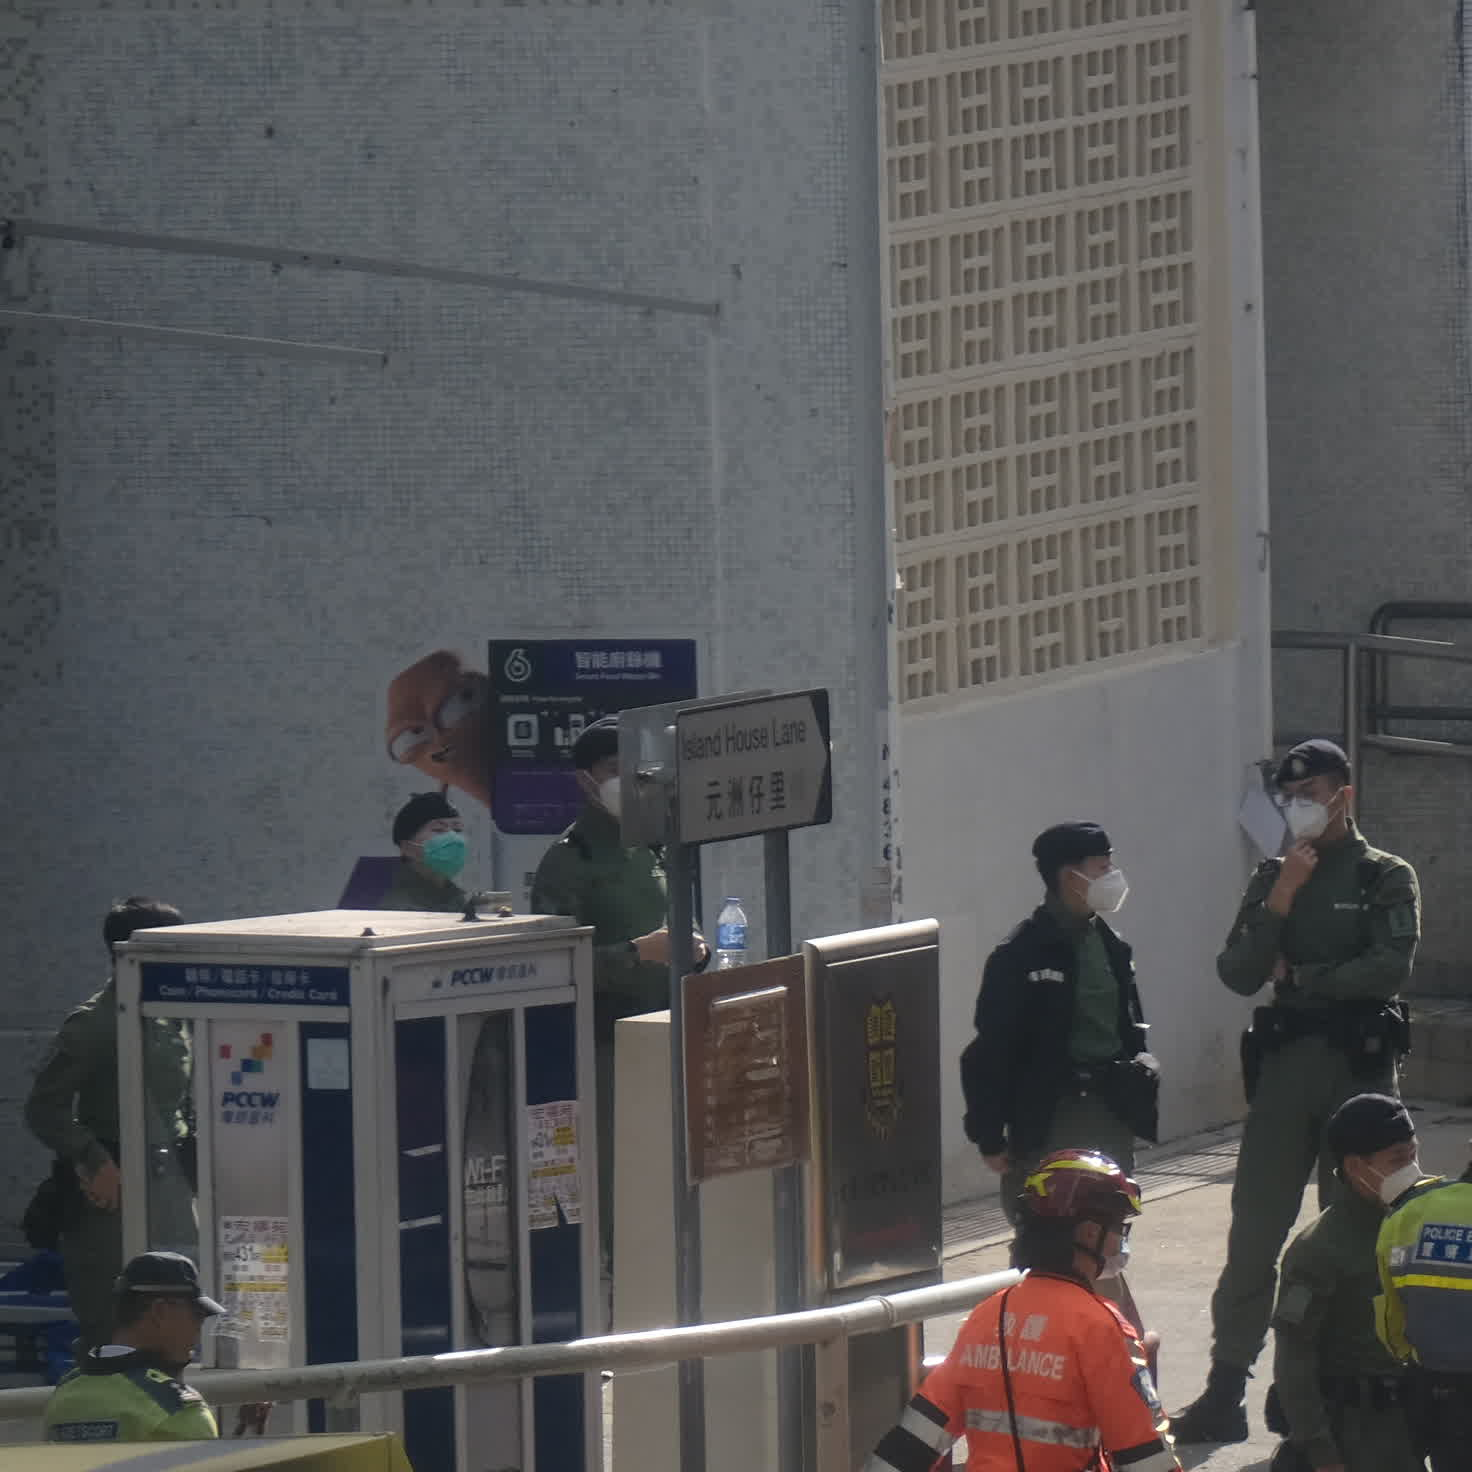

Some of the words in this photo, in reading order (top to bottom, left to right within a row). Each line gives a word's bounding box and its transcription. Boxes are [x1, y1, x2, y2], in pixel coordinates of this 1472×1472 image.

[682, 729, 722, 761] Island
[723, 722, 768, 755] House
[772, 716, 806, 747] Lane
[705, 770, 786, 822] 元洲仔里
[451, 967, 495, 986] PCCW
[222, 1092, 280, 1108] PCCW
[1424, 1227, 1464, 1241] POLICE
[959, 1343, 1068, 1380] AMBLANCE
